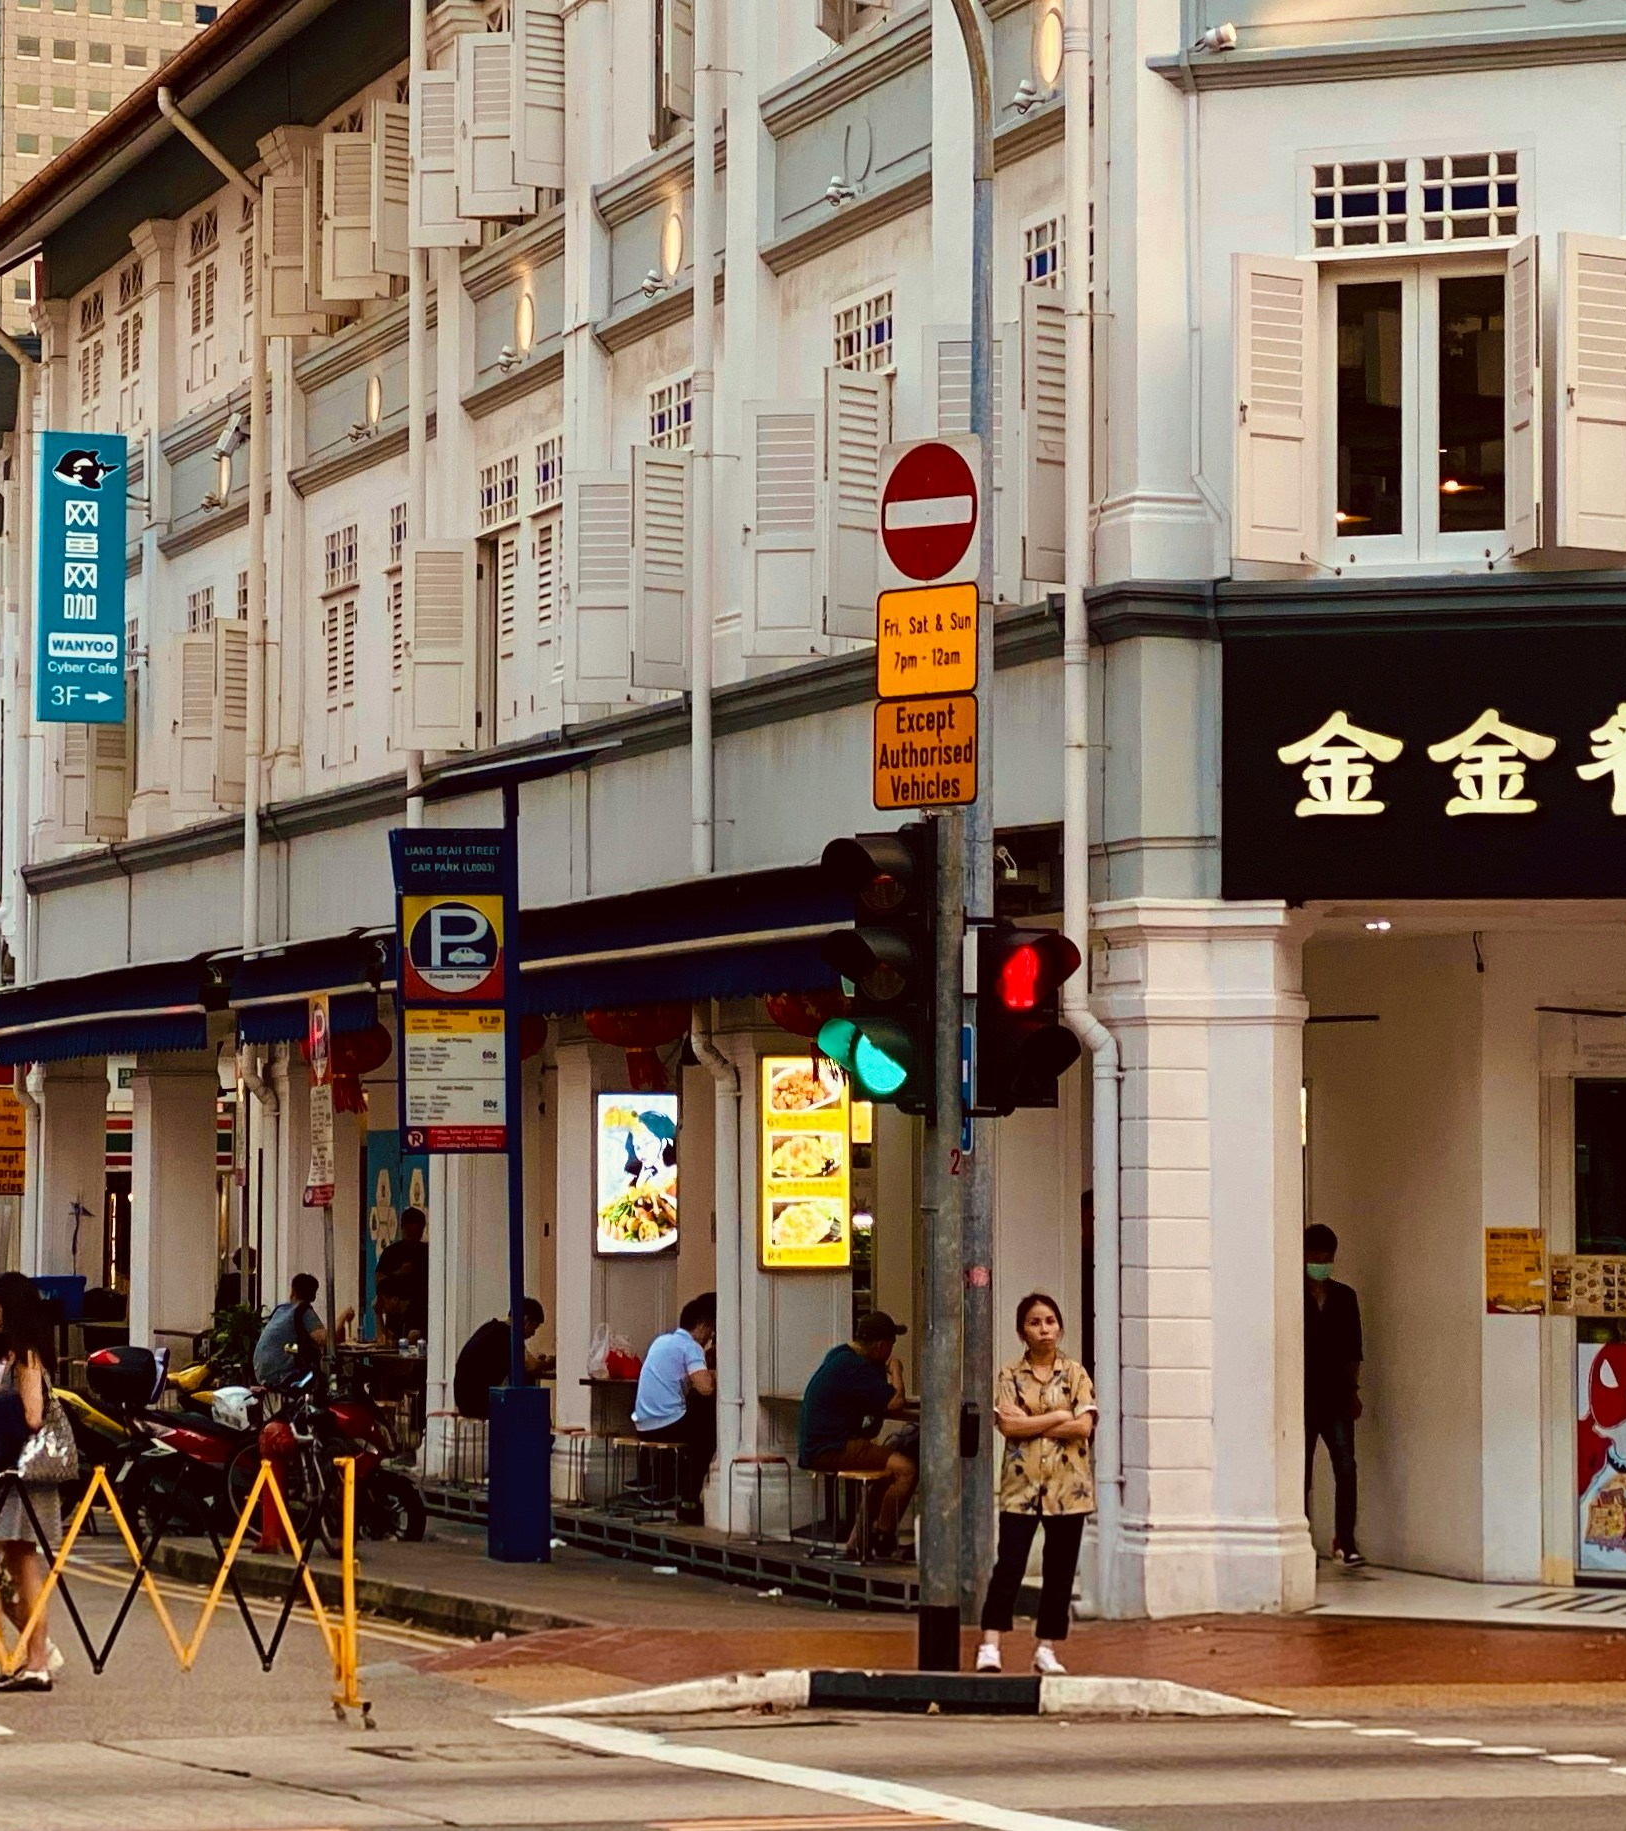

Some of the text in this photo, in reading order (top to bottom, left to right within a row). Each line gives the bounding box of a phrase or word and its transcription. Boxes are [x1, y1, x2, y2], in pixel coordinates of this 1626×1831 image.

[63, 500, 99, 620] 网鱼网咖
[884, 612, 972, 637] Fri, Sat & Sun
[52, 639, 114, 653] WANYOO
[47, 660, 118, 675] Cyber Cafe
[893, 651, 918, 675] 7pm
[931, 648, 961, 667] 12am
[50, 685, 81, 706] 3F
[895, 701, 956, 739] Except
[879, 735, 974, 771] Authorised
[890, 771, 961, 803] Vehicles
[405, 846, 501, 856] LIANG SEAH STREET
[411, 863, 431, 872] CAR
[435, 863, 460, 872] PARK
[950, 1148, 961, 1175] 2
